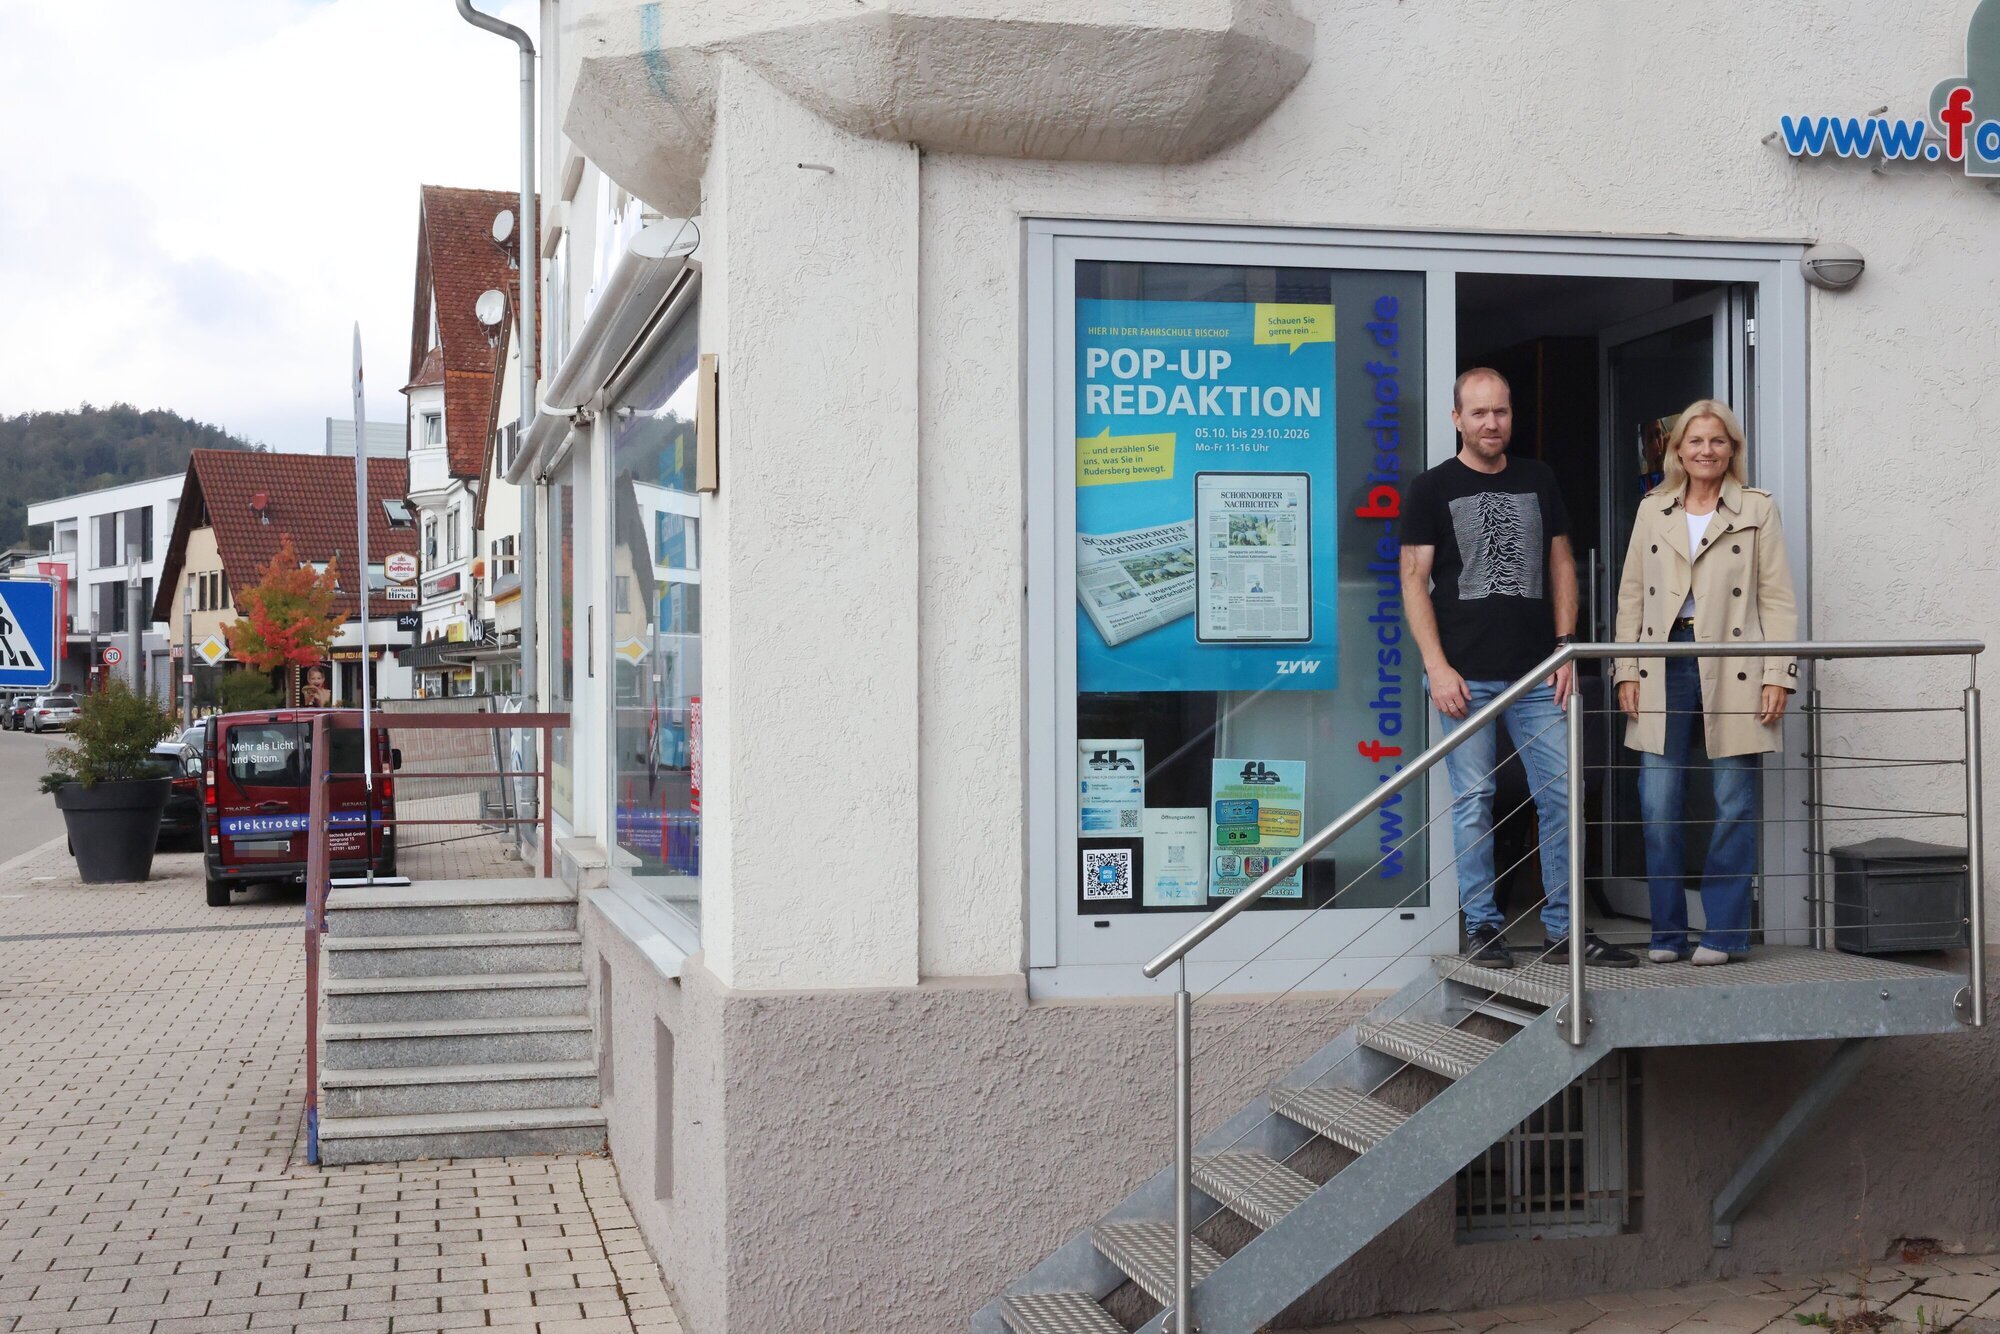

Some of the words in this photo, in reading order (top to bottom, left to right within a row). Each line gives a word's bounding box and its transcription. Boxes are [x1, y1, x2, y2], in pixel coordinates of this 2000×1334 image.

[1268, 317, 1301, 325] Schauen
[1303, 316, 1315, 324] Sie
[1088, 327, 1107, 336] HIER
[1109, 327, 1119, 336] IN
[1121, 327, 1137, 336] DER
[1140, 328, 1192, 337] FAHRSCHULE
[1194, 328, 1230, 338] BISCHOF
[1268, 328, 1292, 337] gerne
[1293, 326, 1309, 334] rein
[1086, 347, 1232, 380] POP-UP
[1086, 384, 1320, 417] REDAKTION
[1195, 427, 1228, 438] 05.10.
[1231, 428, 1248, 439] bis
[1250, 428, 1310, 439] 29.10.2026
[1092, 446, 1108, 454] und
[1110, 445, 1145, 454] erzählen
[1147, 444, 1159, 452] Sie
[1195, 442, 1222, 451] Mo-Fr
[1225, 443, 1250, 452] 11-16
[1252, 443, 1270, 452] Uhr
[1121, 456, 1133, 464] Sie
[1135, 455, 1143, 463] in
[1084, 466, 1130, 476] Rudersberg
[1132, 465, 1166, 475] bewegt.
[1220, 491, 1283, 499] SCHORNDORFER
[1224, 500, 1280, 508] NACHRICHTEN
[1081, 525, 1186, 546] SCHORNDORFER
[1096, 532, 1190, 556] NACHRICHTEN
[400, 615, 418, 628] sky
[107, 651, 118, 661] 30
[231, 743, 254, 752] Mehr
[256, 742, 269, 751] als
[271, 741, 294, 750] Licht
[232, 755, 248, 764] und
[250, 755, 280, 763] Strom.
